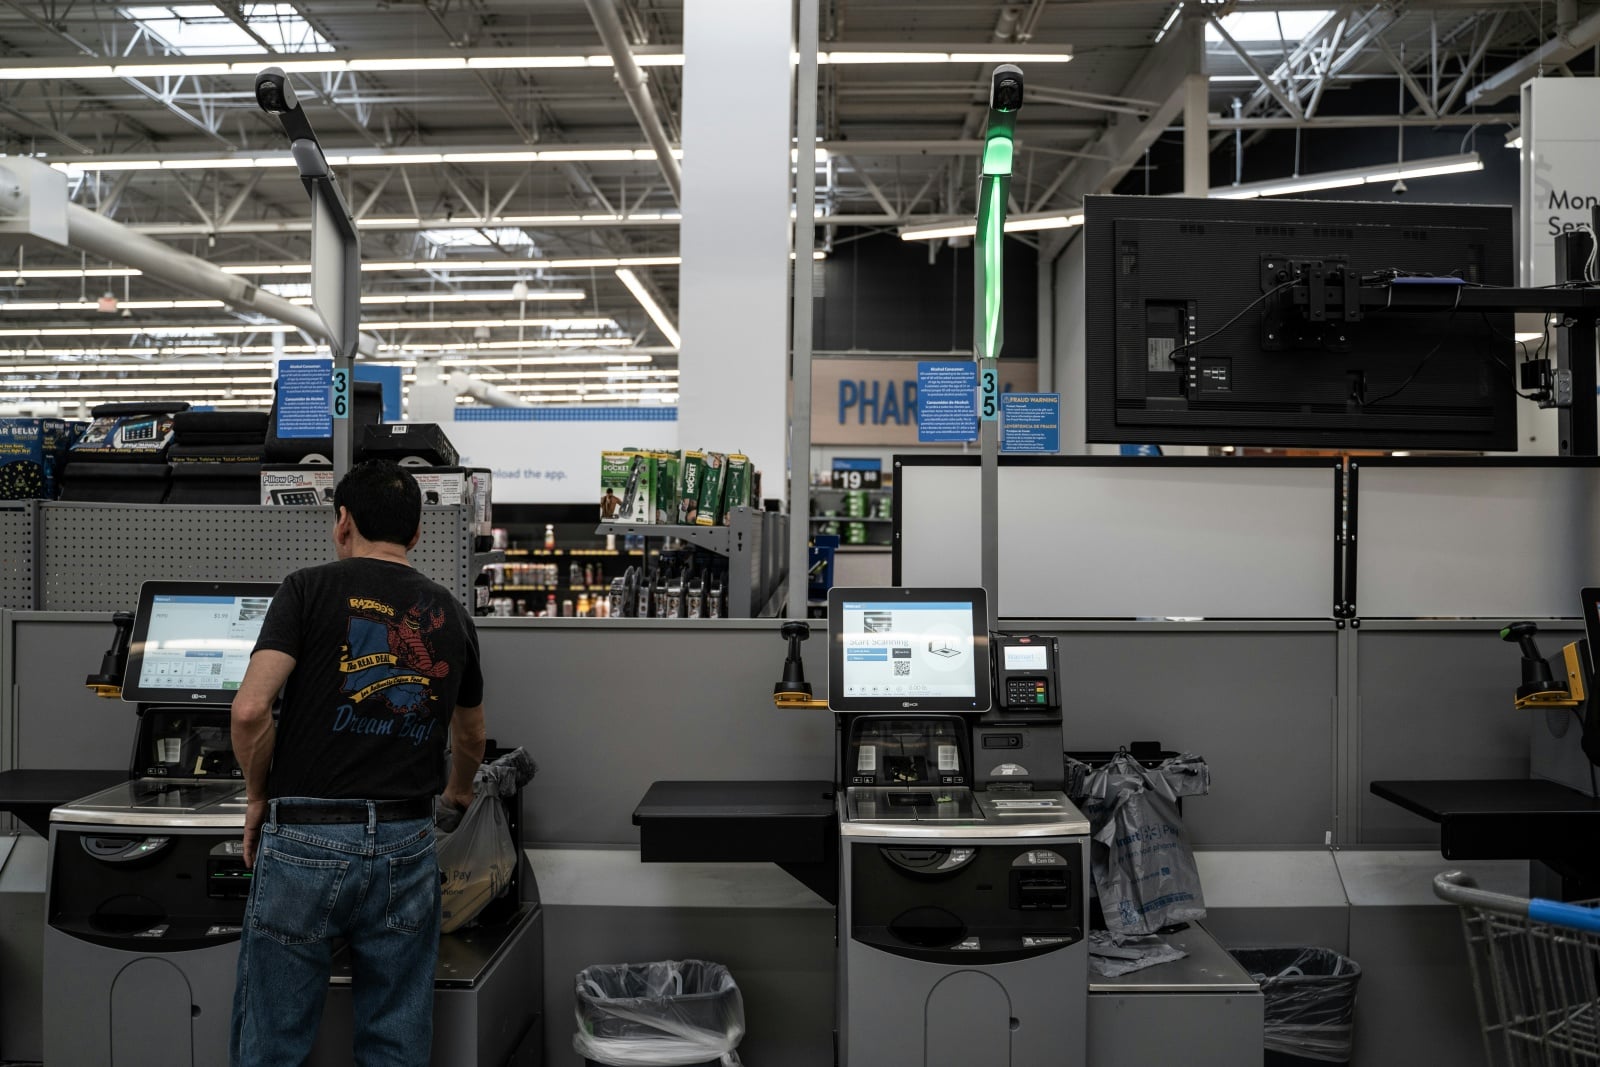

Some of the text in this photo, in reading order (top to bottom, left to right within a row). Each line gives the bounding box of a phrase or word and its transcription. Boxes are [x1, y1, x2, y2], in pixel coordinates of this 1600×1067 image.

[1549, 190, 1600, 210] Mon
[838, 379, 918, 425] PHAR
[12, 427, 39, 435] BELLY
[263, 475, 304, 483] Pillow Pad
[492, 468, 567, 483] nload the app.
[686, 464, 697, 493] ROCKET
[872, 638, 909, 647] Scanning
[347, 655, 391, 671] The REAL DEAL
[333, 704, 436, 746] Dream Big!
[454, 870, 472, 881] Pay
